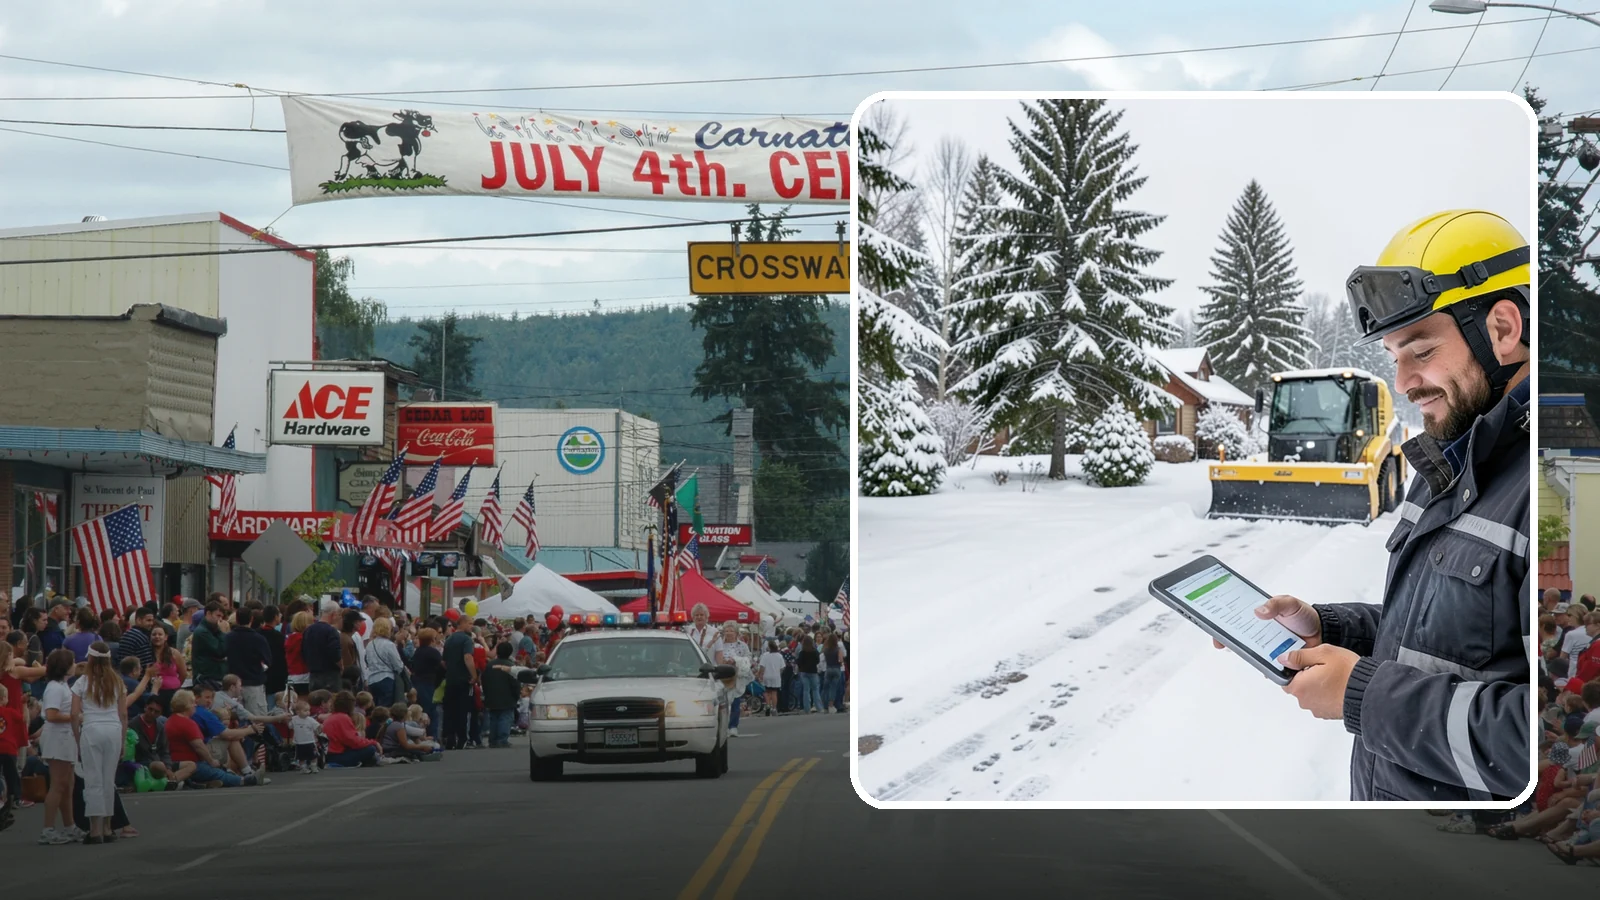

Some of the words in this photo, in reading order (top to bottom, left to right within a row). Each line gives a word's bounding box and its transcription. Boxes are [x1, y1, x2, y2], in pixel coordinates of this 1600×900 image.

[481, 140, 605, 193] JULY
[632, 150, 746, 198] 4th.
[697, 254, 850, 280] CROSSWA
[283, 380, 373, 419] ACE
[405, 409, 452, 421] CEDAR
[283, 421, 370, 436] Hardware
[416, 428, 477, 447] Coca-Cola
[353, 467, 384, 481] Simpl
[95, 485, 124, 495] Vincent
[126, 486, 135, 495] de
[137, 486, 155, 495] Paul
[688, 526, 741, 535] CRNATION
[699, 535, 730, 543] GLASS
